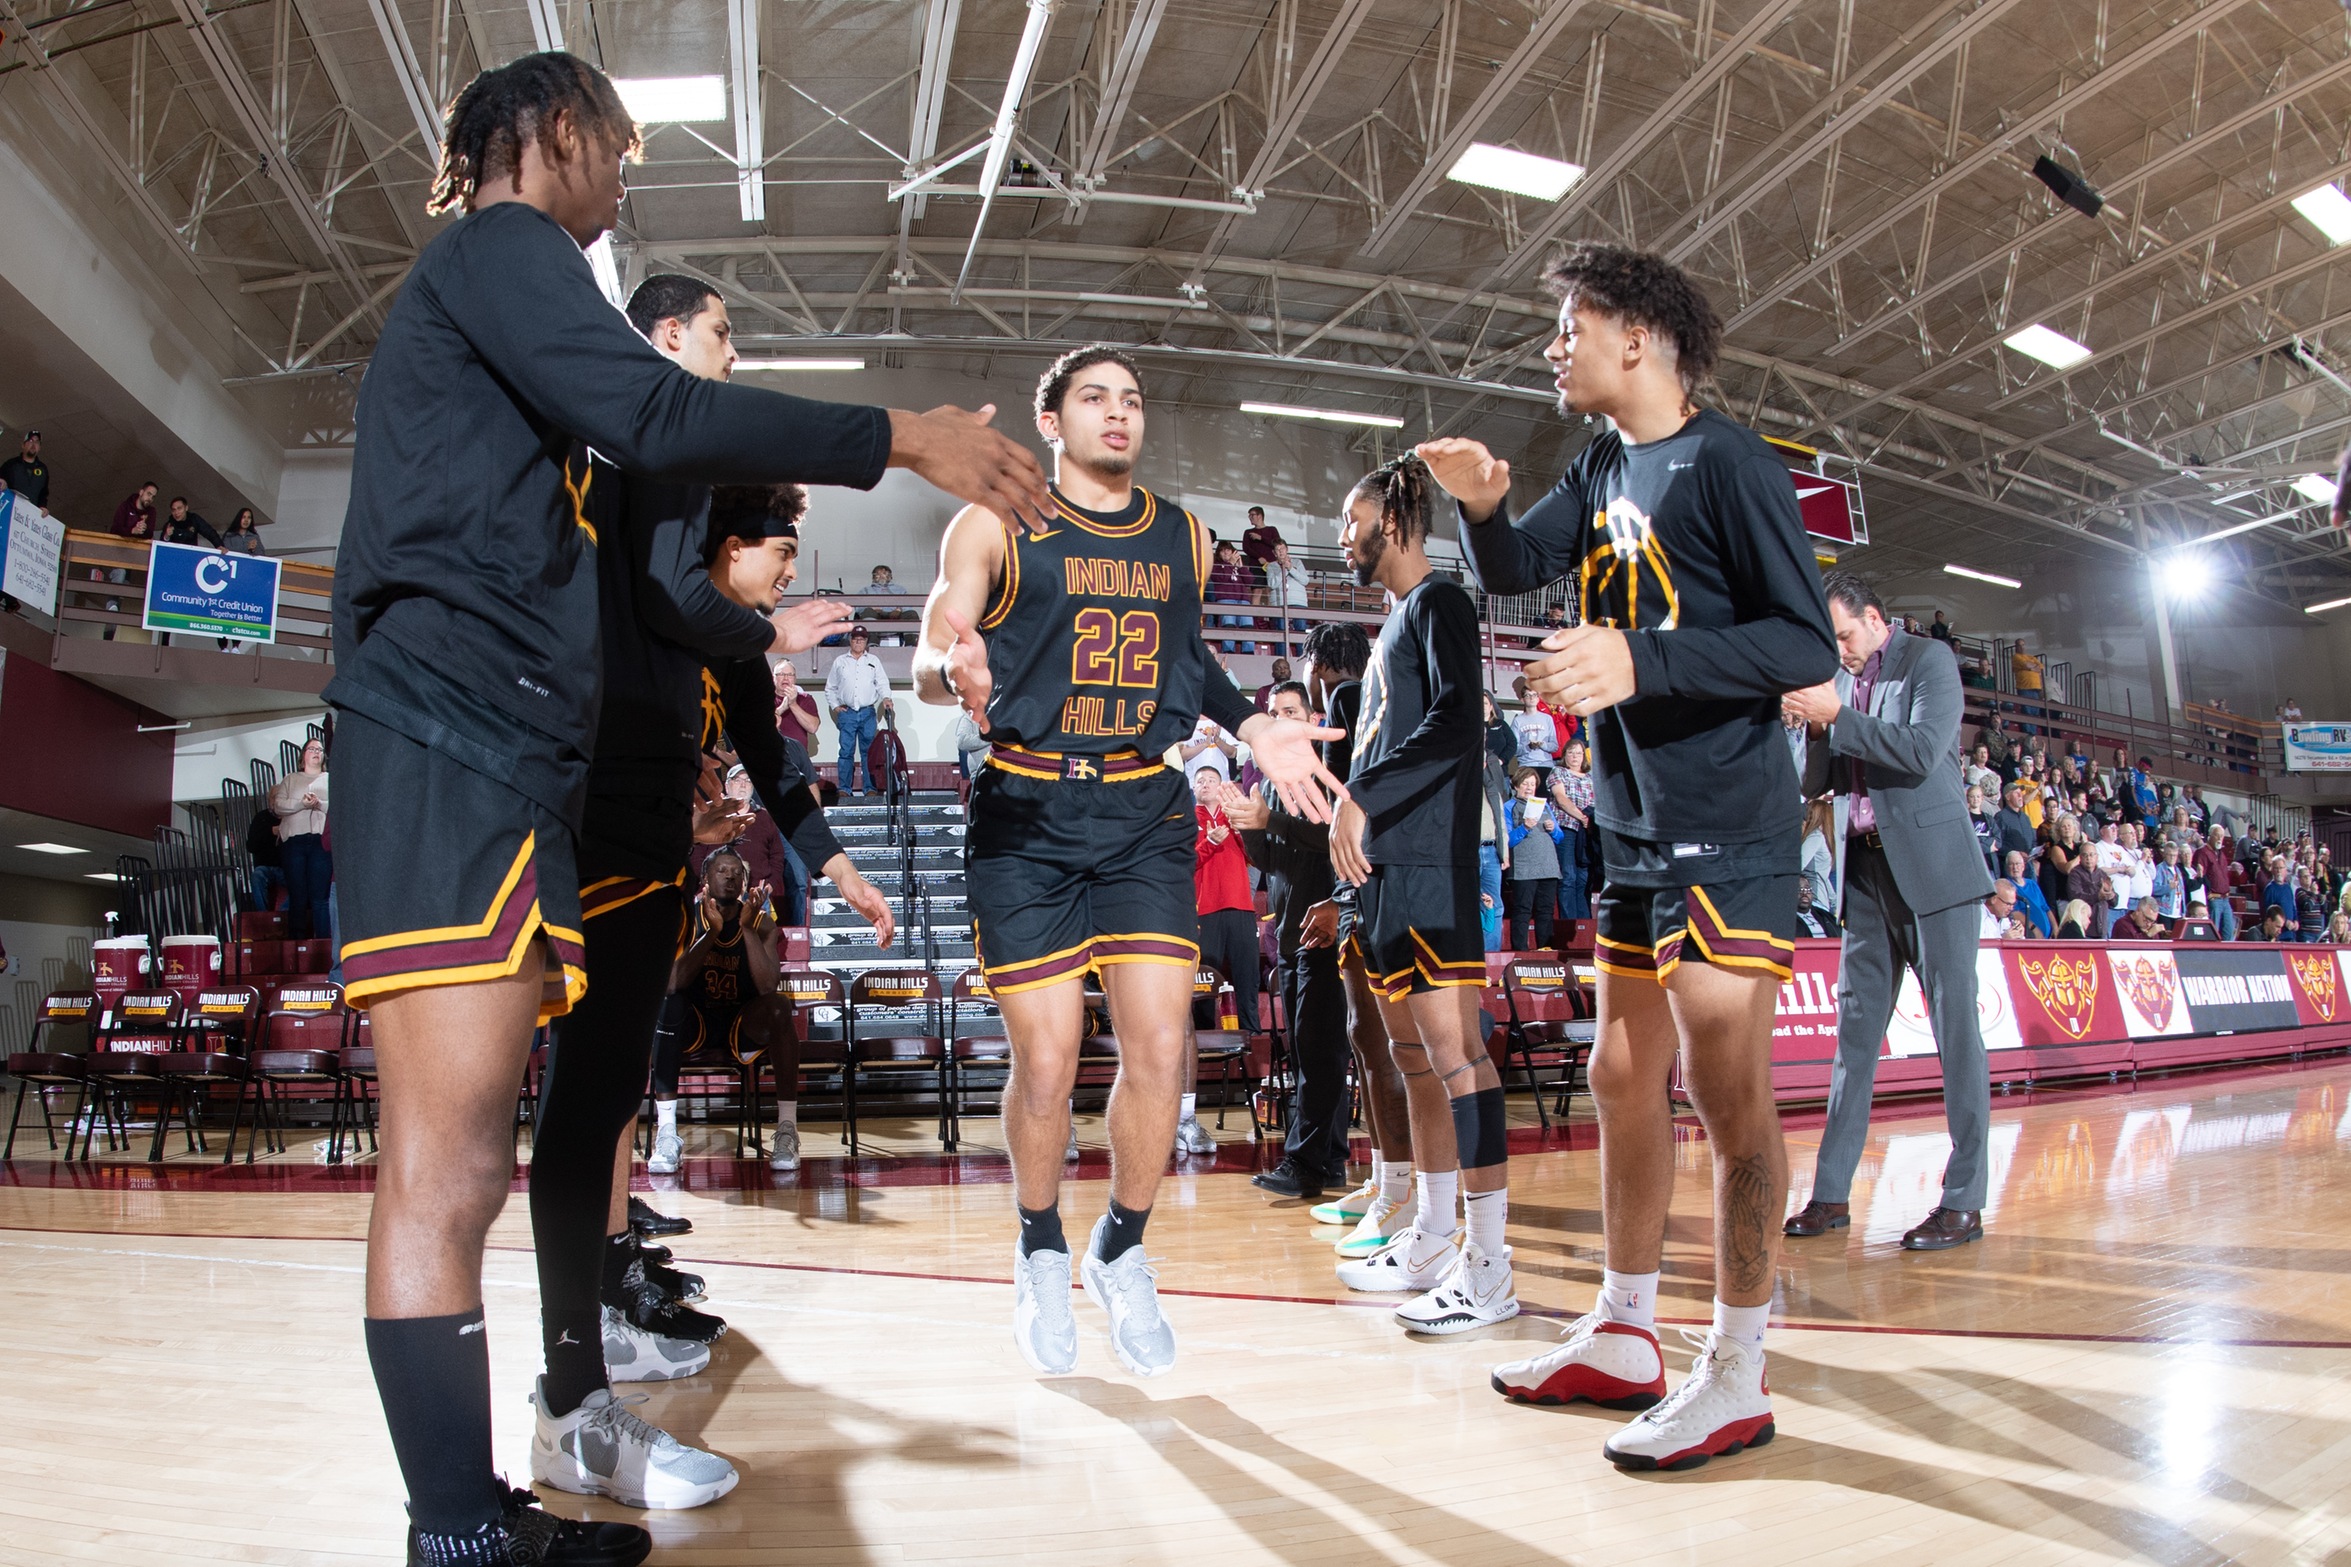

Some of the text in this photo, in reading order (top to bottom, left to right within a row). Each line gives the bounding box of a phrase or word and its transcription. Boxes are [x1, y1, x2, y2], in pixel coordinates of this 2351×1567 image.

[42, 525, 53, 543] Glass
[1065, 557, 1171, 602] INDIAN
[161, 591, 263, 613] Community 1st Credit Union
[210, 609, 262, 622] Together is Better
[1071, 607, 1160, 689] 22
[518, 677, 549, 697] DRI-FIT
[1061, 696, 1157, 736] HILLS
[2291, 728, 2330, 744] Bowling
[1514, 965, 1566, 978] INDIAN HILLS
[705, 970, 737, 999] 34
[802, 979, 832, 992] HILLS
[864, 976, 928, 989] INDIAN HILLS
[280, 989, 338, 1002] INDIAN HILLS
[2181, 974, 2294, 1007] WARRIOR NATION
[47, 997, 93, 1008] INDIAN HILLS
[123, 995, 173, 1008] INDIAN HILLS
[199, 993, 250, 1005] INDIAN HILLS
[887, 1004, 911, 1012] people
[1794, 1024, 1814, 1036] the
